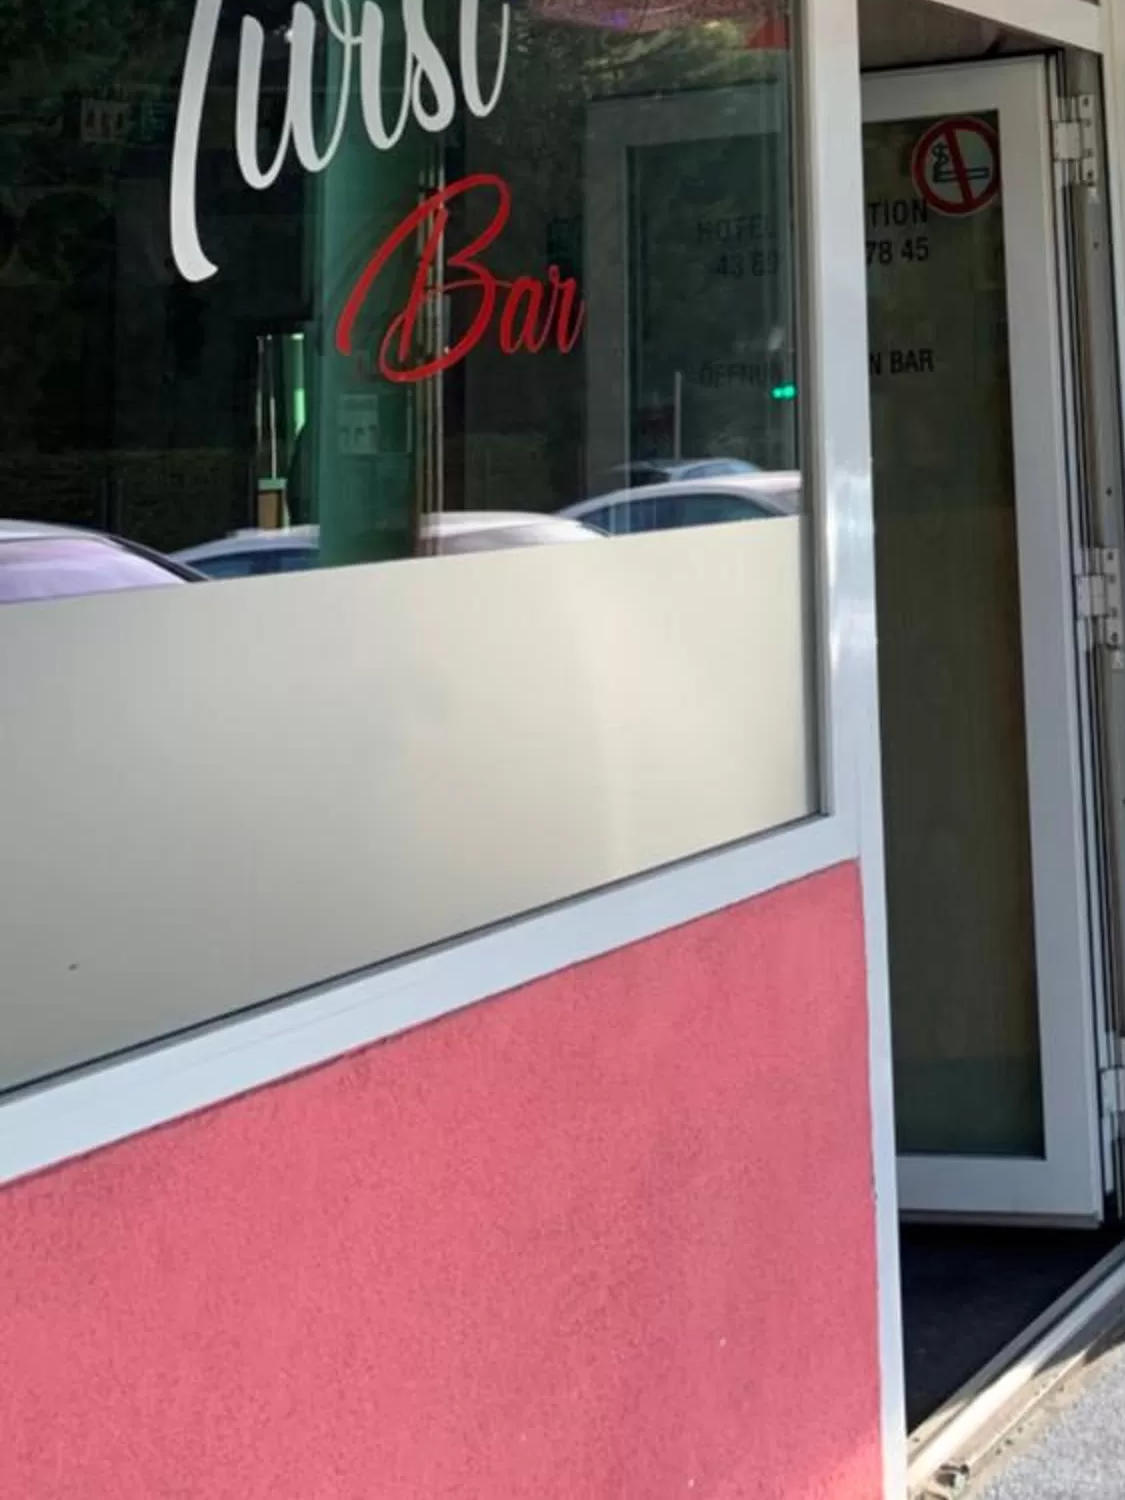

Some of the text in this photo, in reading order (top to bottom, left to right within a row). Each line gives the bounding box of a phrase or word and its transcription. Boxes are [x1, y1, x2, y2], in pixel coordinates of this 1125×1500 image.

[900, 236, 929, 262] 45
[335, 174, 586, 382] Bar
[890, 348, 935, 374] BAR
